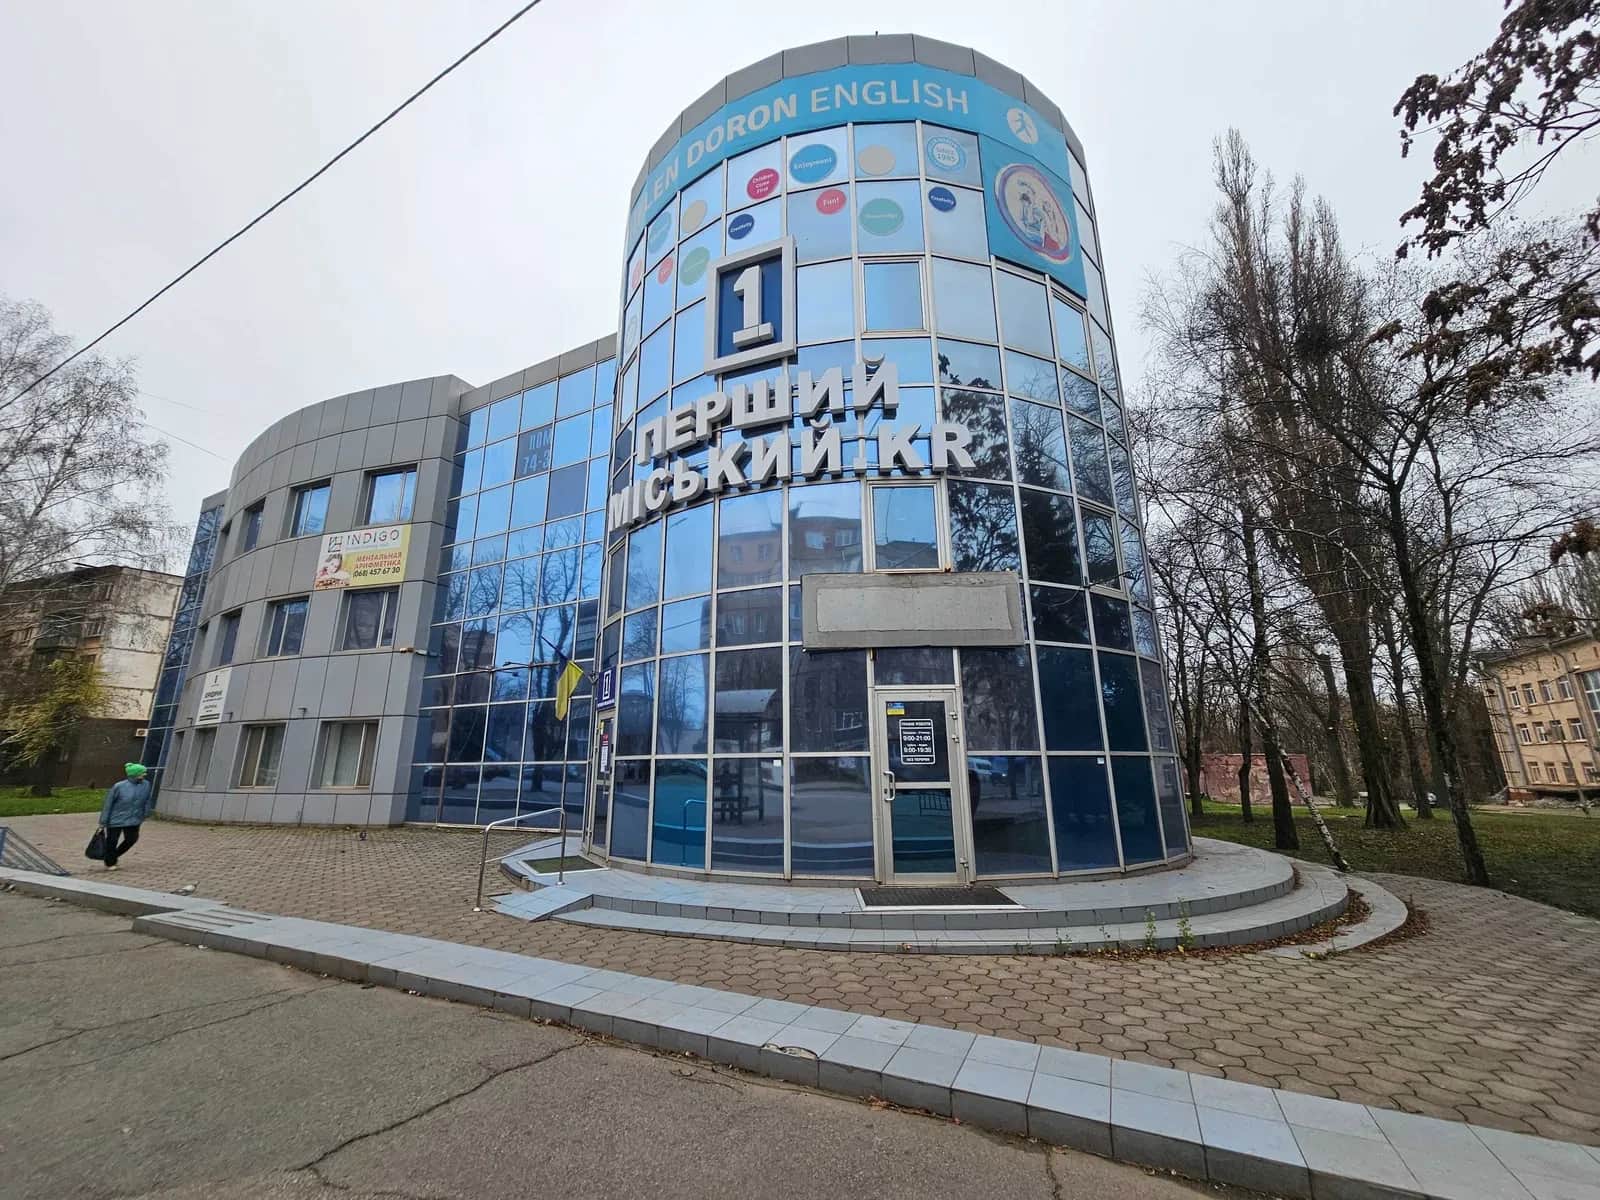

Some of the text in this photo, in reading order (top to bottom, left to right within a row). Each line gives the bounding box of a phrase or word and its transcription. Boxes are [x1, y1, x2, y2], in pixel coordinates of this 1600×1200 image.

[687, 94, 797, 168] DORON
[810, 79, 969, 115] ENGLISH
[793, 156, 832, 170] Enjoyment
[733, 264, 775, 350] 1
[637, 352, 899, 467] ПЕРШИЙ
[346, 529, 400, 545] INDIGO
[369, 568, 381, 577] 457
[382, 566, 390, 575] 67
[391, 566, 401, 574] 30
